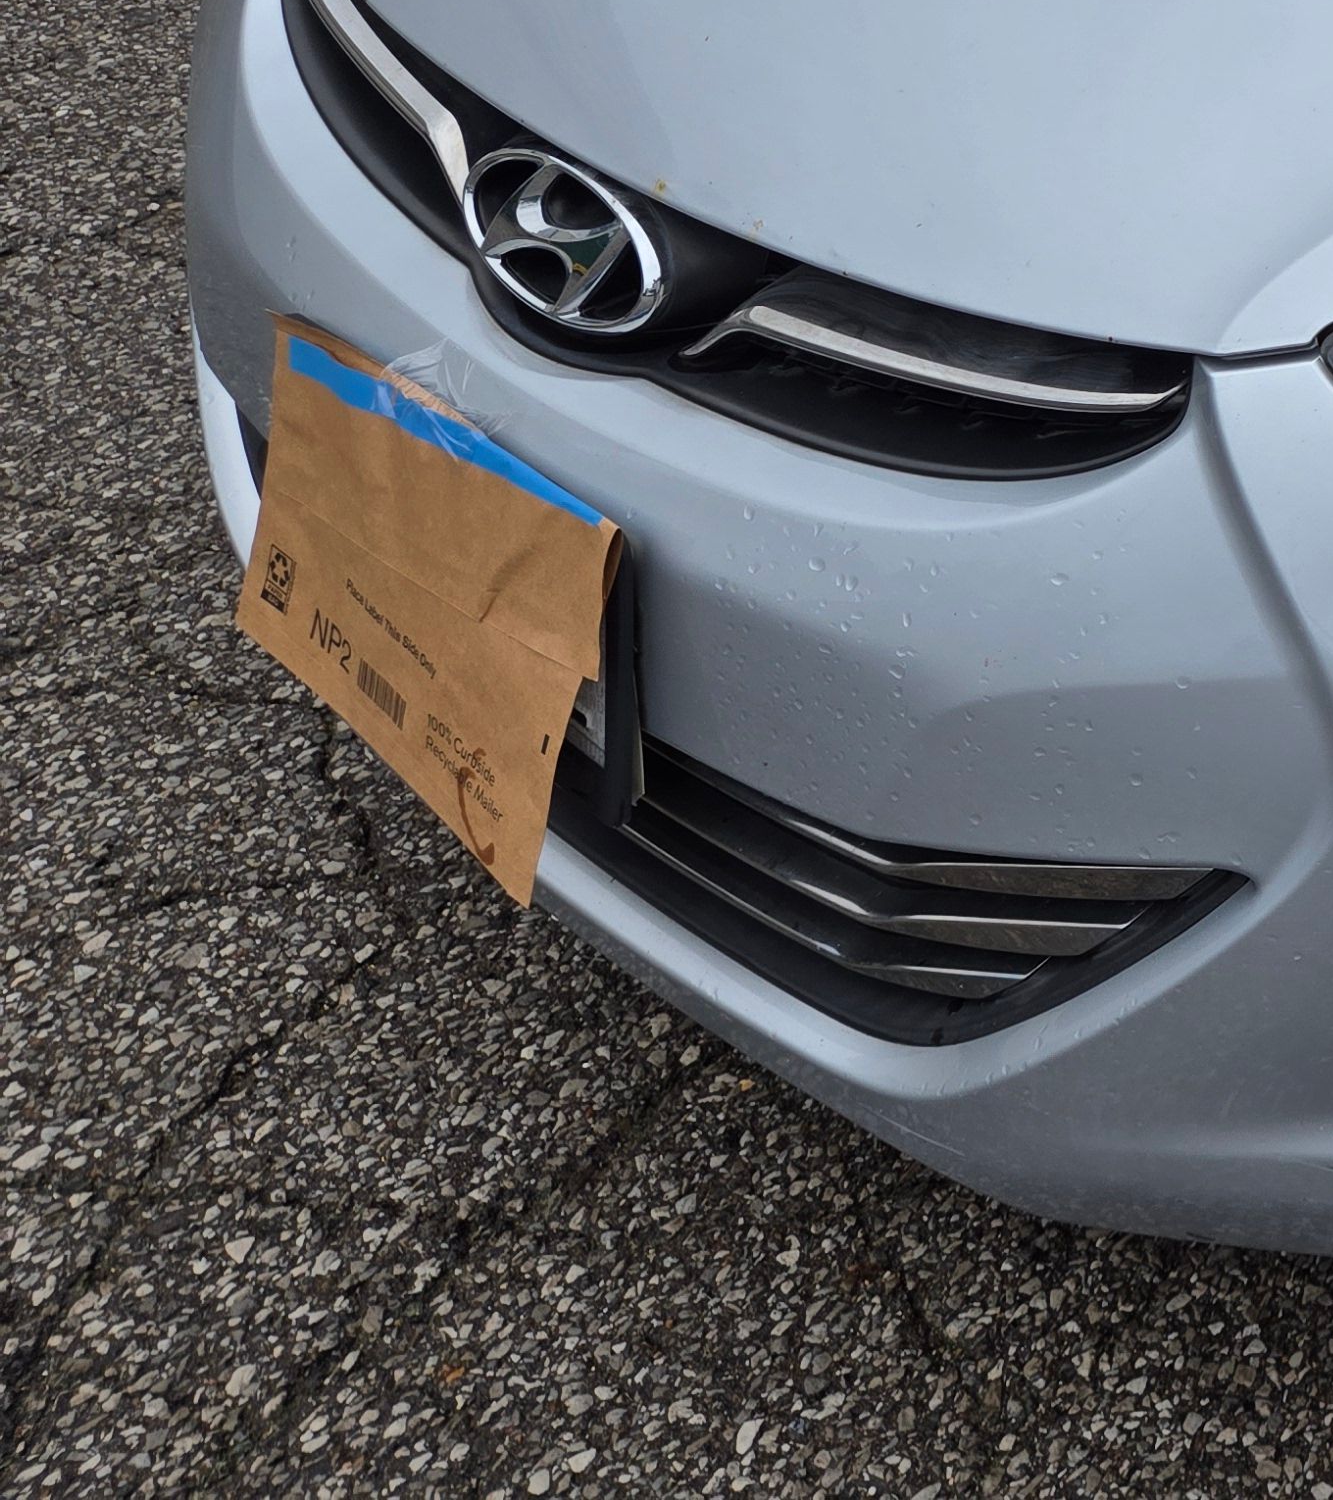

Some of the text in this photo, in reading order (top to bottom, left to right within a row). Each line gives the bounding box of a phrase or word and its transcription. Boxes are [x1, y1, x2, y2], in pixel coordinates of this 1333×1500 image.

[310, 607, 352, 674] NP2
[346, 578, 437, 679] Place Label This Side Only
[425, 735, 503, 822] Recyclable Mailer
[427, 713, 495, 787] 100% Curbside
